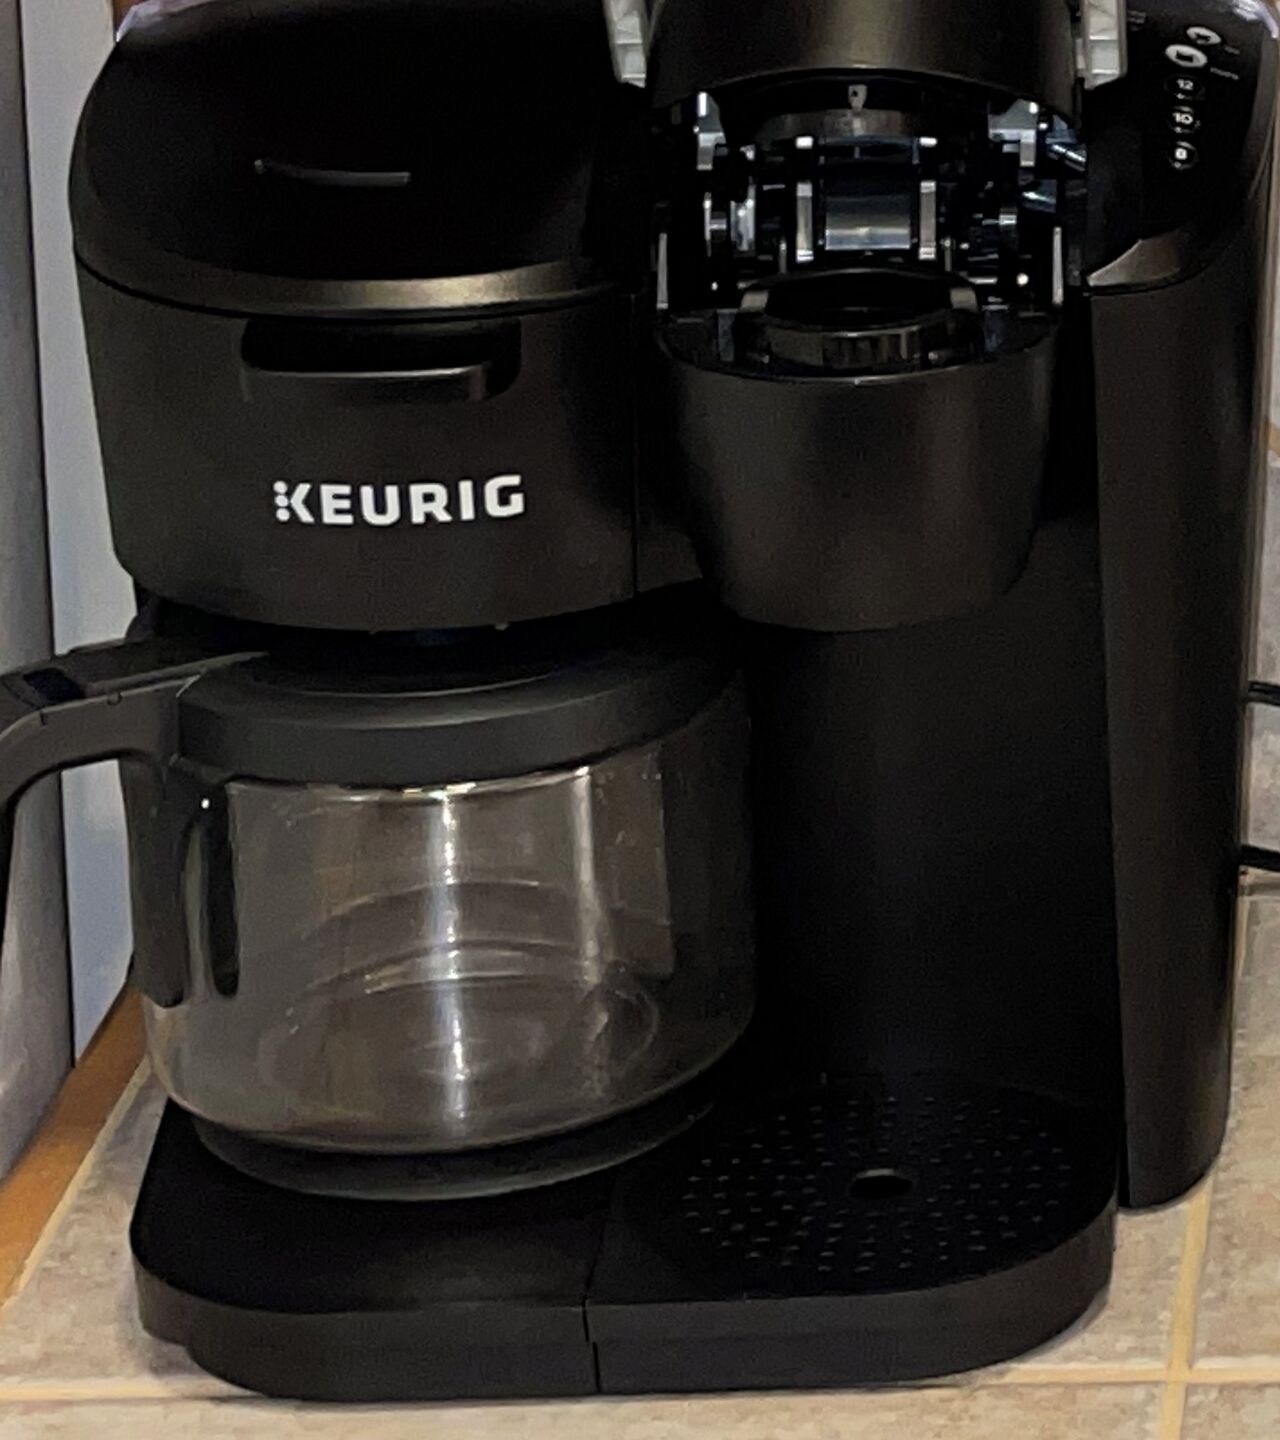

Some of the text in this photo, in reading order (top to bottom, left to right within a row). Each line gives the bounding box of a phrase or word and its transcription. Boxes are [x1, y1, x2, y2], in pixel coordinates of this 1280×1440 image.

[1175, 78, 1194, 91] 12
[1171, 112, 1194, 125] 10
[273, 473, 526, 528] KEURIG
